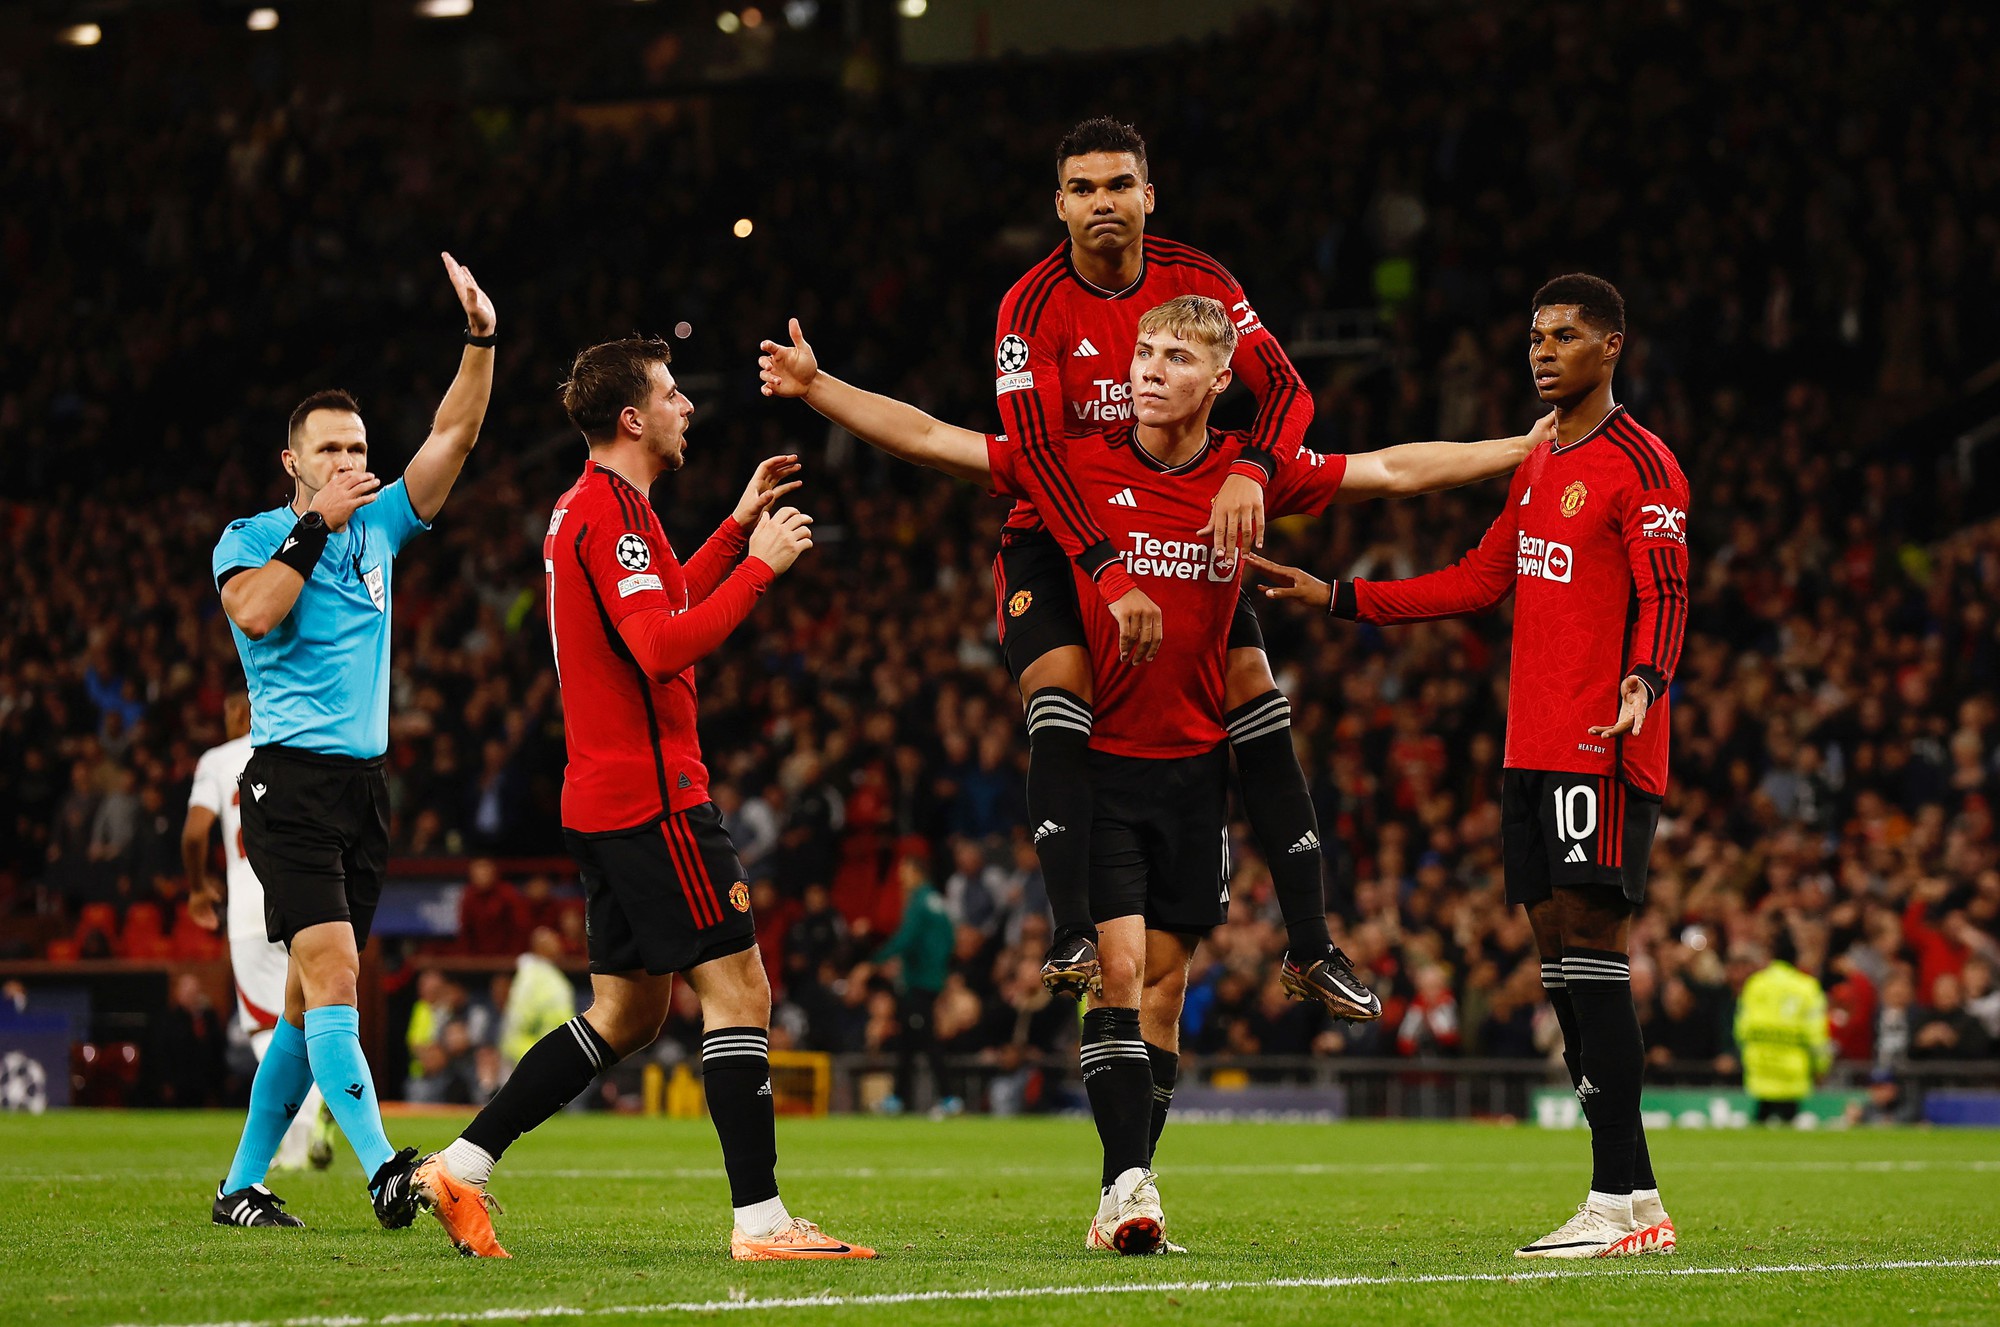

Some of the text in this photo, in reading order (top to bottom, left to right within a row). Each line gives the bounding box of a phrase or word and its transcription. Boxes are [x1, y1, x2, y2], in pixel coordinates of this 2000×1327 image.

[1093, 379, 1132, 403] Tea
[1073, 399, 1136, 421] View
[1128, 531, 1208, 561] Team
[1518, 530, 1545, 557] Team
[1553, 785, 1597, 843] 10
